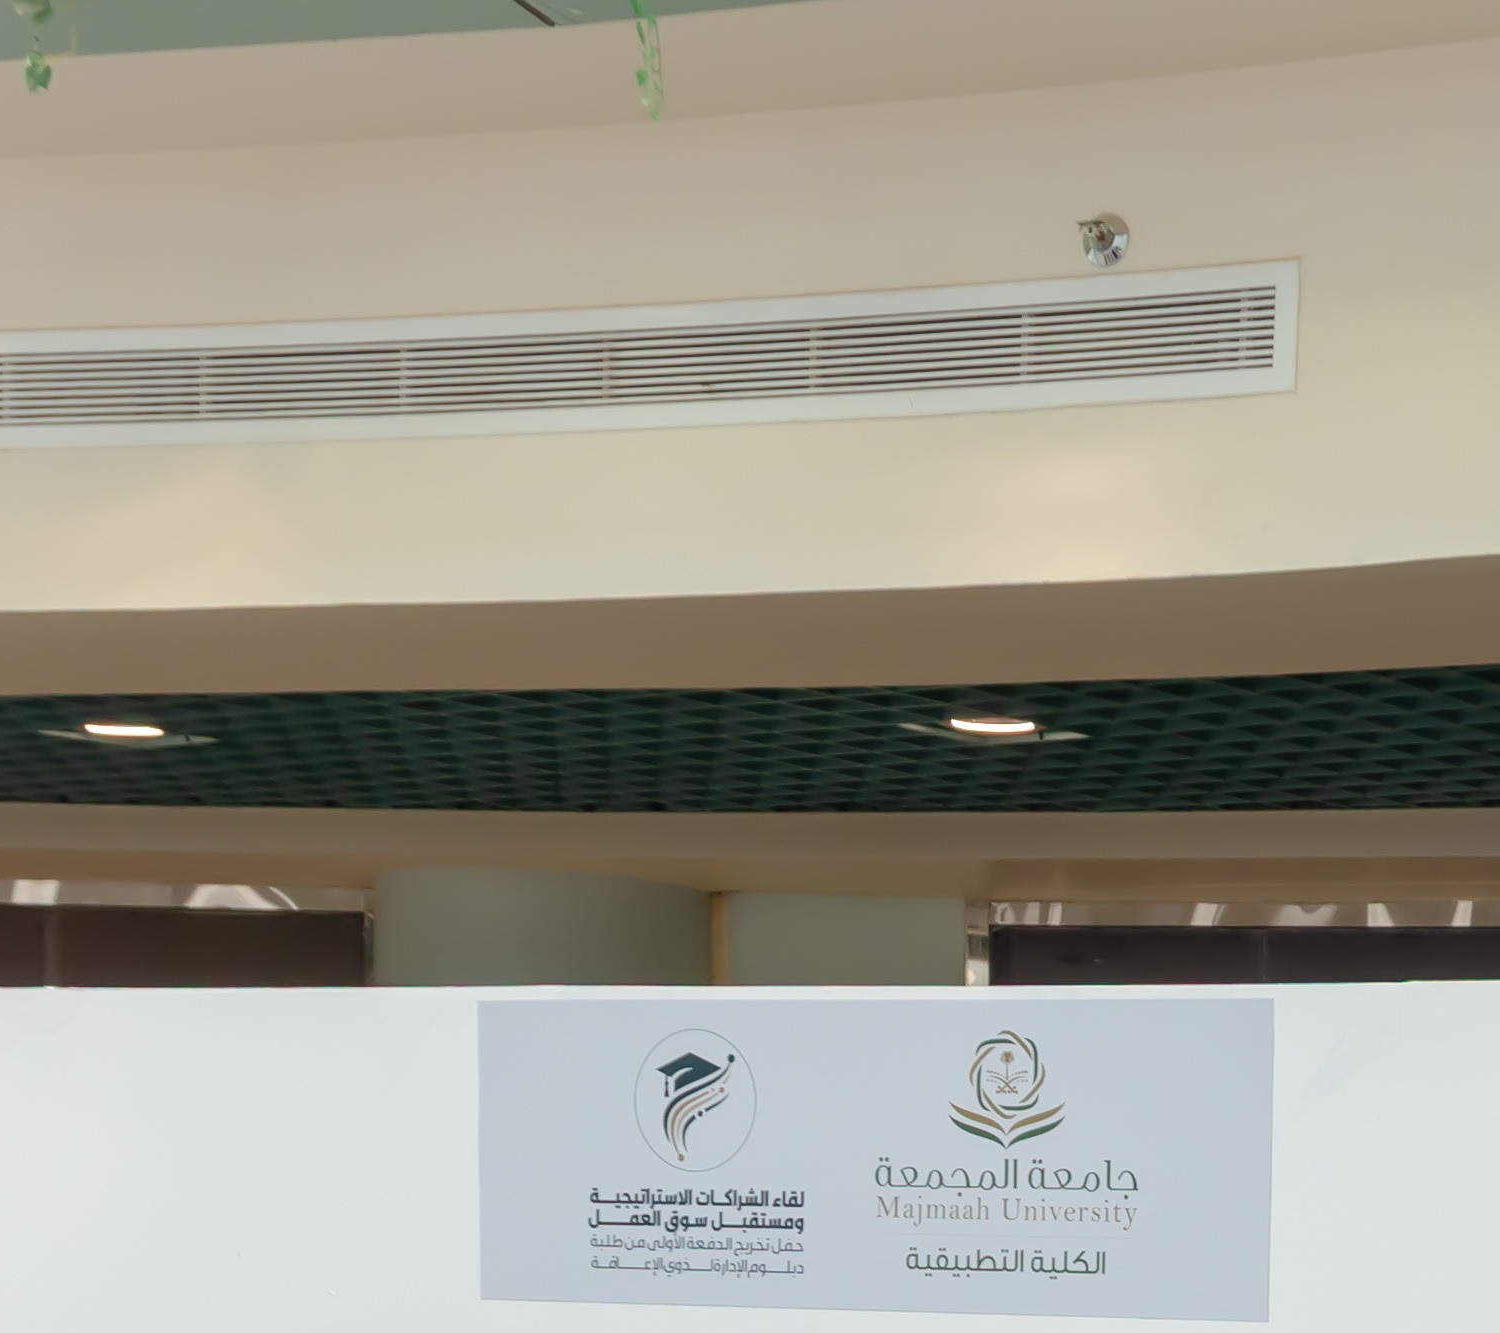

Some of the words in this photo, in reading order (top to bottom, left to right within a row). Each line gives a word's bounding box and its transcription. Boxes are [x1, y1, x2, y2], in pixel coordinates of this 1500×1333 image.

[873, 1156, 1019, 1199] المجمعة
[1027, 1158, 1140, 1201] جامعة
[588, 1186, 694, 1210] الاستراتيجية
[694, 1187, 770, 1212] الشراكات
[771, 1189, 806, 1209] لقاء
[587, 1208, 662, 1229] العمل
[663, 1209, 709, 1233] سوق
[709, 1210, 805, 1235] ومستقبل
[875, 1193, 990, 1228] Majmaah
[1001, 1196, 1138, 1232] University
[589, 1233, 624, 1252] طلبة
[685, 1236, 733, 1251] الدفعة
[770, 1237, 805, 1255] حفل
[905, 1246, 1025, 1279] التطبيقية
[1029, 1249, 1107, 1281] الكلية
